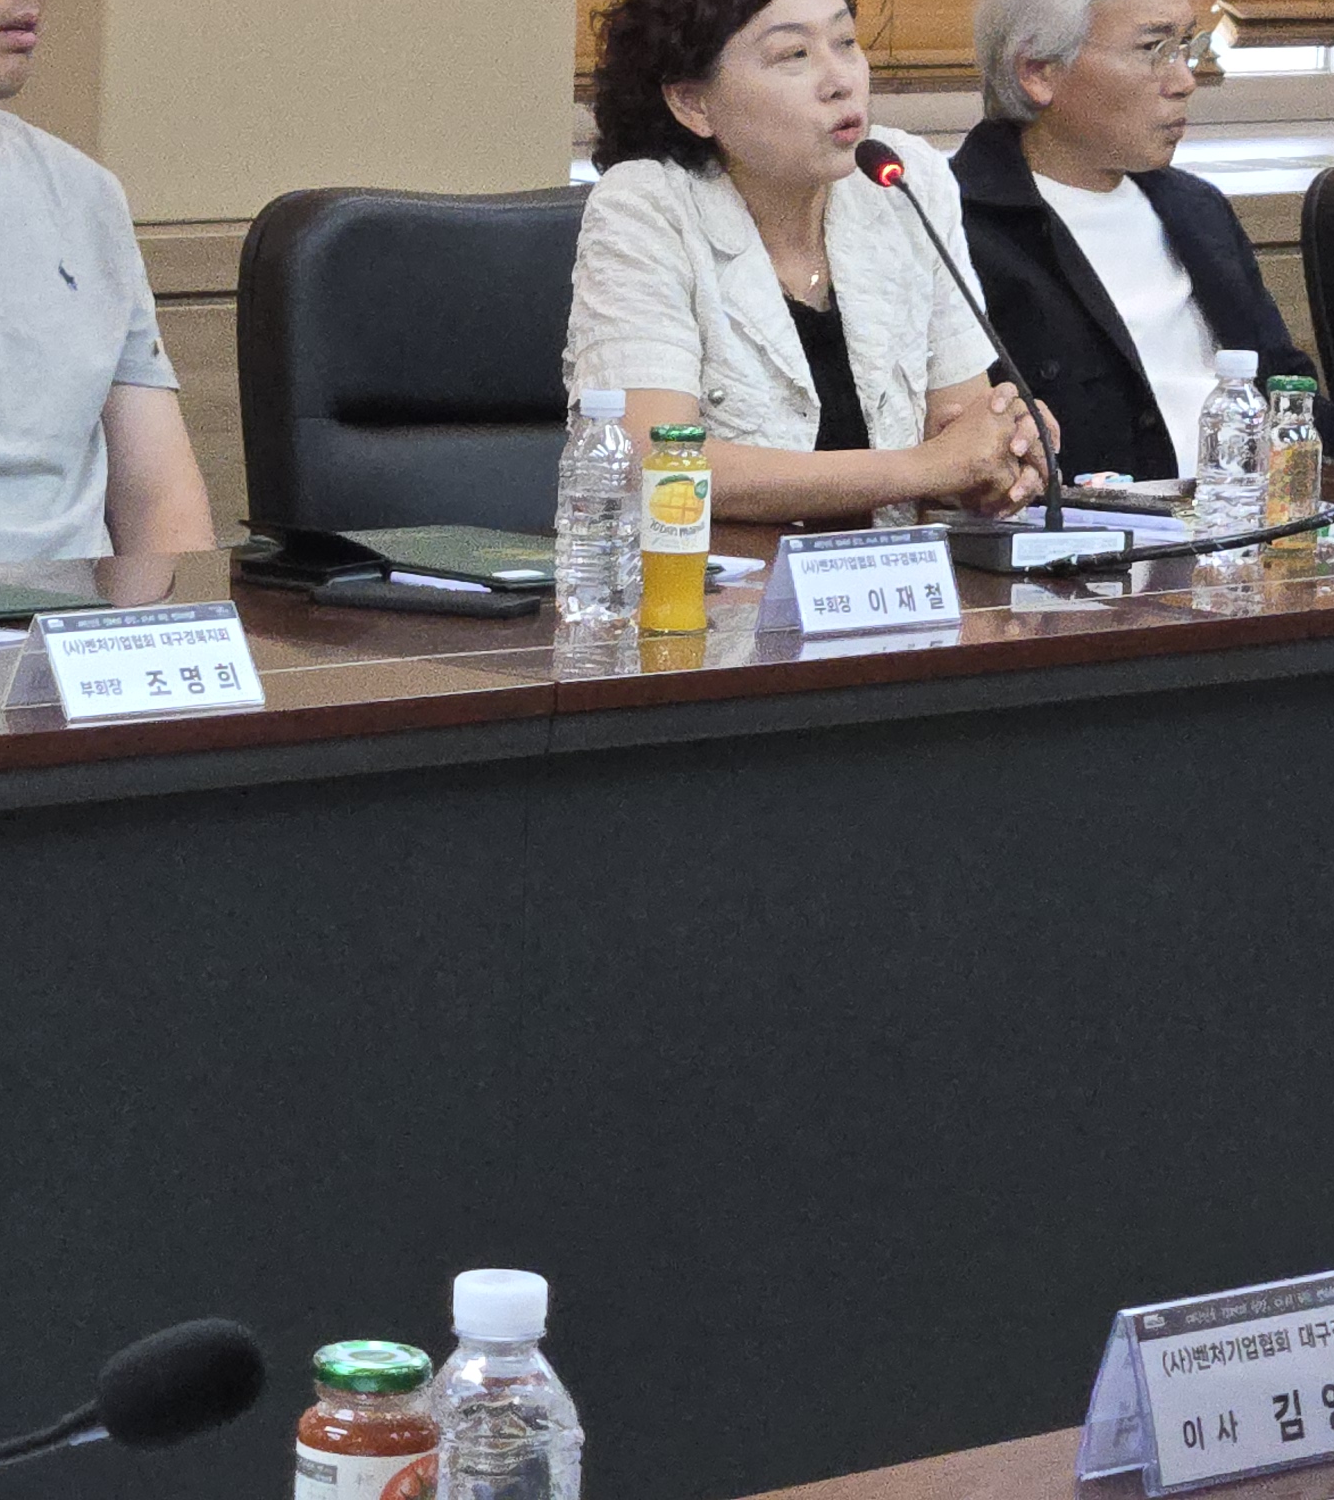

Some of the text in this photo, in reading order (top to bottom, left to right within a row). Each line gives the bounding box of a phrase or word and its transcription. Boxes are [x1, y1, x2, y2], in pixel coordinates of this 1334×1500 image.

[813, 582, 945, 615] 부회장 이재철
[79, 661, 242, 698] 부회장 조명희
[1161, 1327, 1292, 1378] (사)벤처기업협회
[1182, 1409, 1239, 1451] 이사
